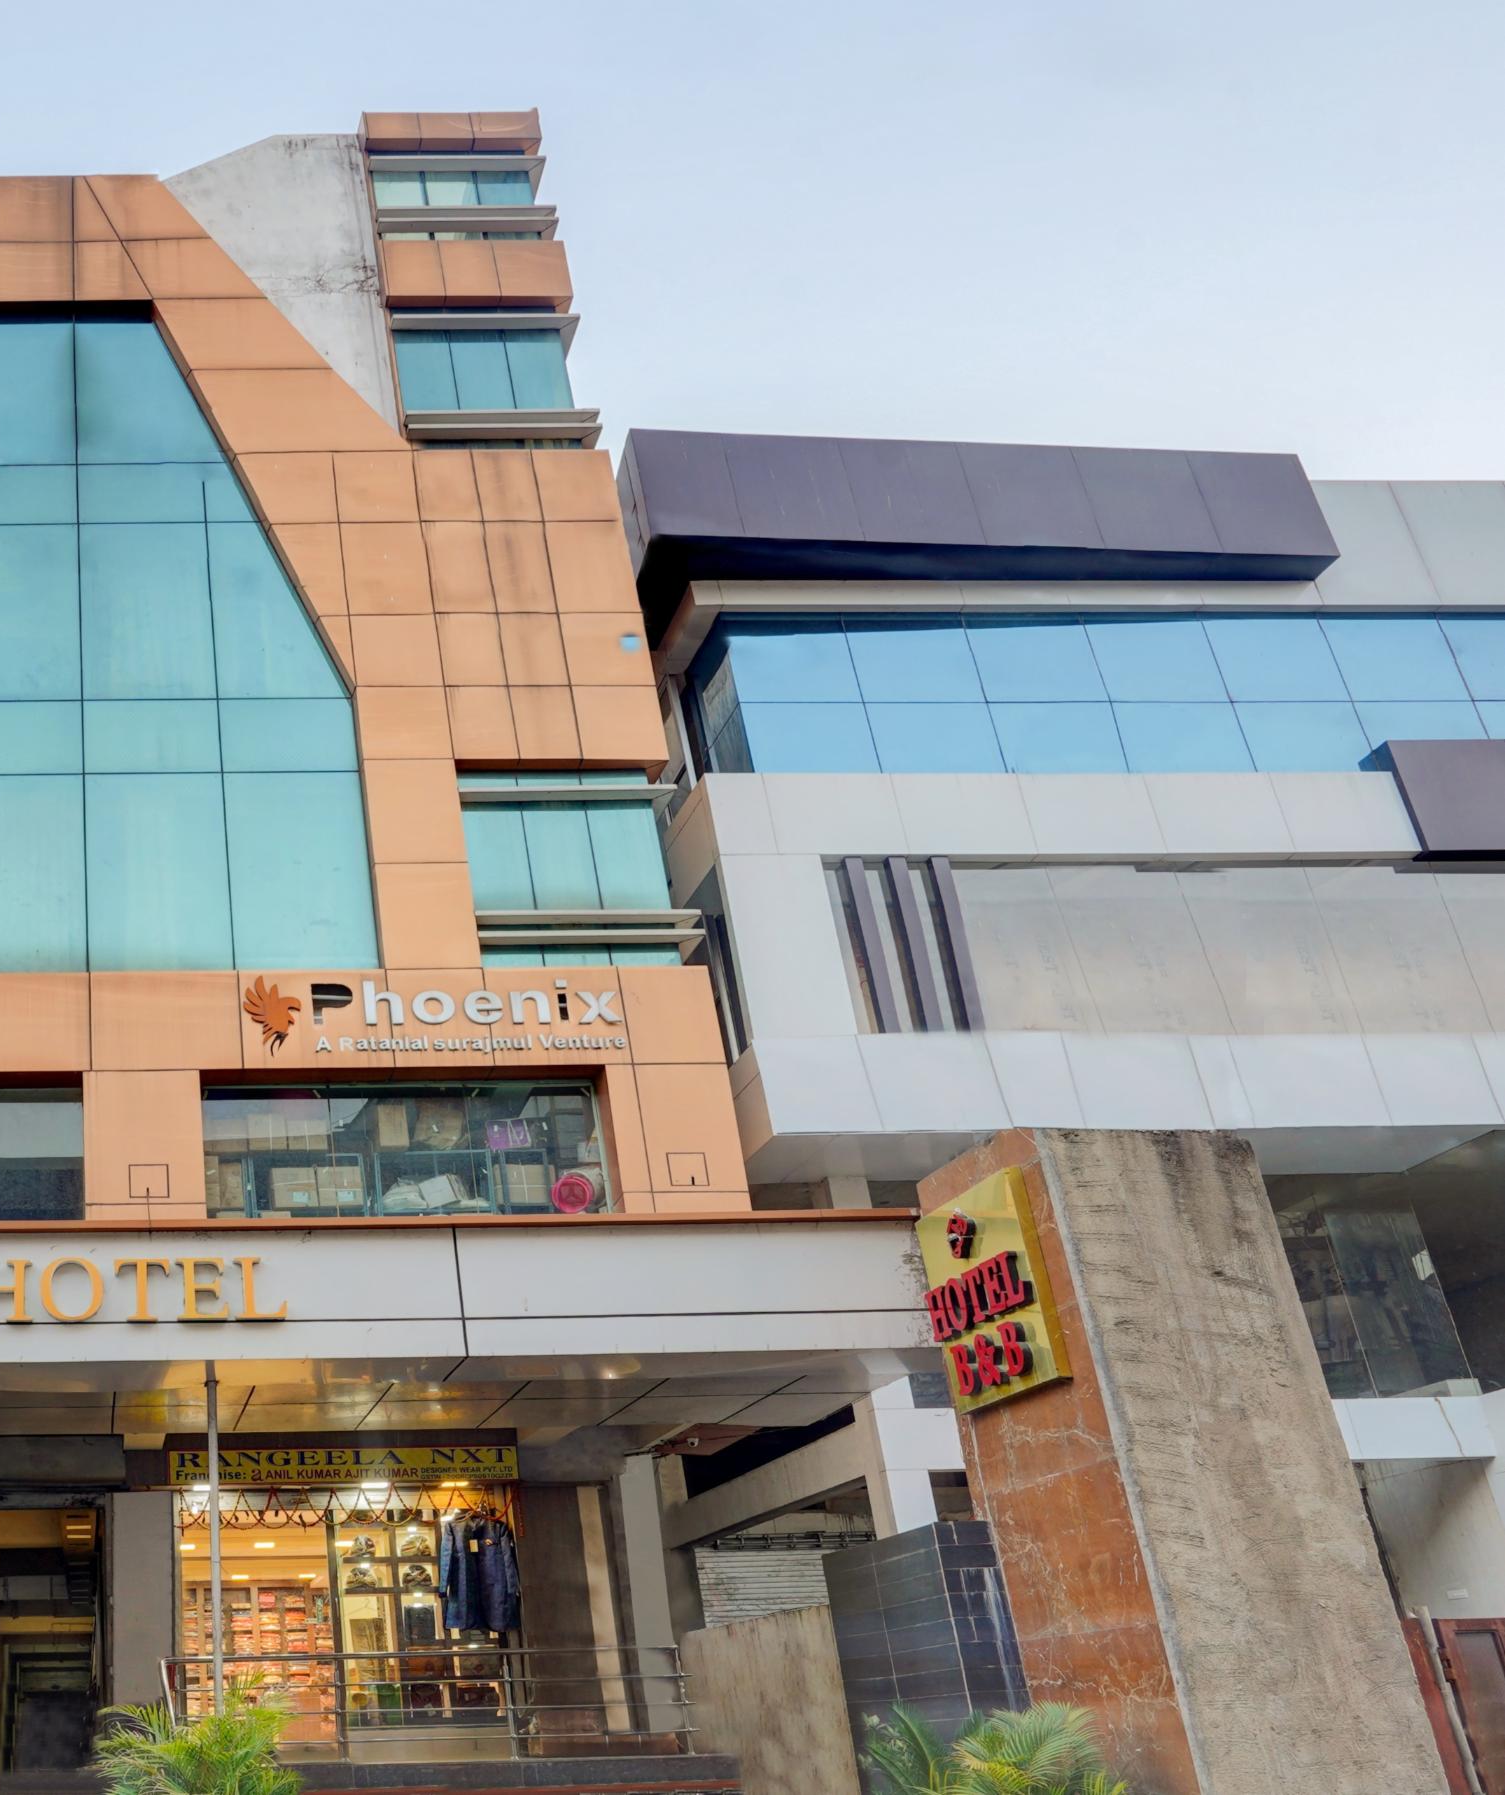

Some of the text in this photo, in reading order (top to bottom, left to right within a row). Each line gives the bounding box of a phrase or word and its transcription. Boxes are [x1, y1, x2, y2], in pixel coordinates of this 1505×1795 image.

[311, 978, 622, 1026] Phoenix
[315, 1034, 627, 1054] A Ratanlal surajmul Venture
[924, 1251, 1026, 1343] HOTEL
[949, 1321, 1026, 1396] B&B
[175, 1470, 246, 1481] Franise:
[265, 1469, 293, 1480] ANIL
[296, 1468, 341, 1479] KUMAR
[345, 1467, 370, 1479] AJIT
[374, 1467, 419, 1478] KUMAR
[176, 1447, 512, 1468] RANGEELA NXT
